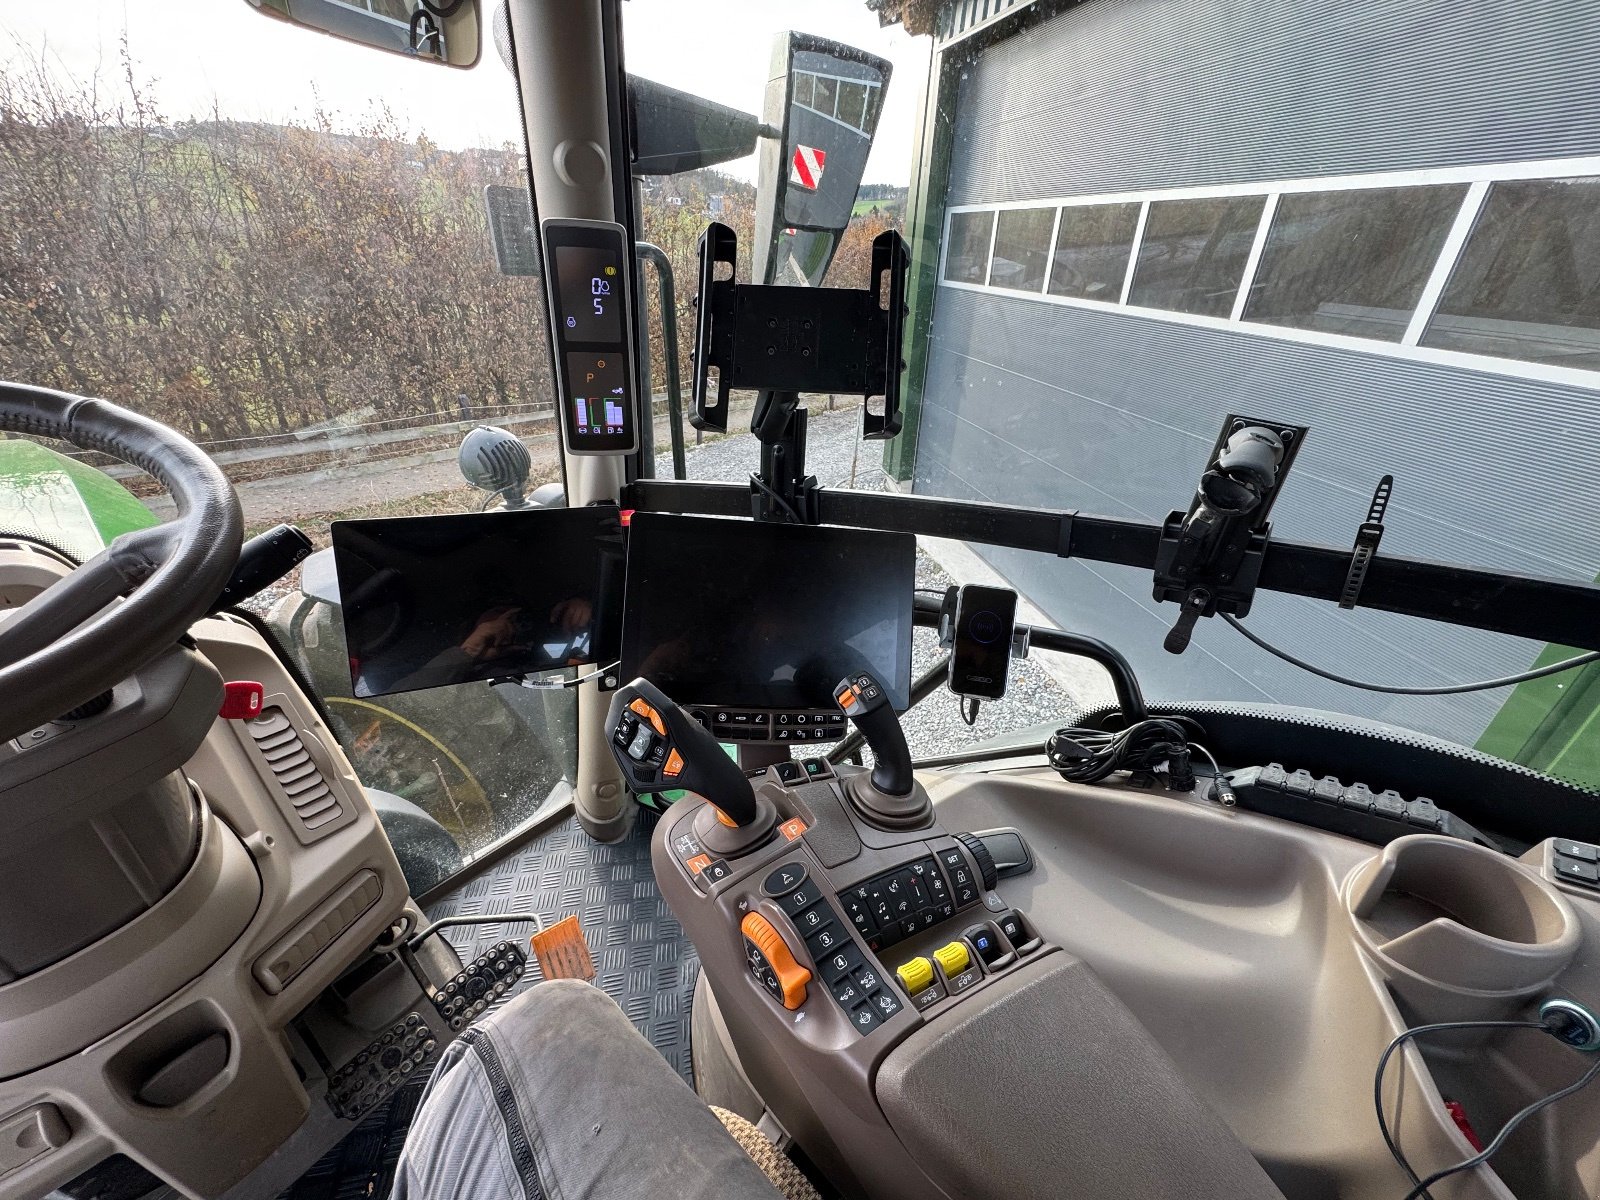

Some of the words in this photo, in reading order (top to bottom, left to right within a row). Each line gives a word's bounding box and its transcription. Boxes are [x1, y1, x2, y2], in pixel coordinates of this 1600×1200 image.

[594, 298, 603, 315] 5
[586, 373, 594, 382] P
[788, 824, 798, 836] P
[694, 858, 707, 870] N
[947, 854, 959, 864] SET
[865, 979, 876, 989] AUTO
[885, 1003, 897, 1014] AUTO
